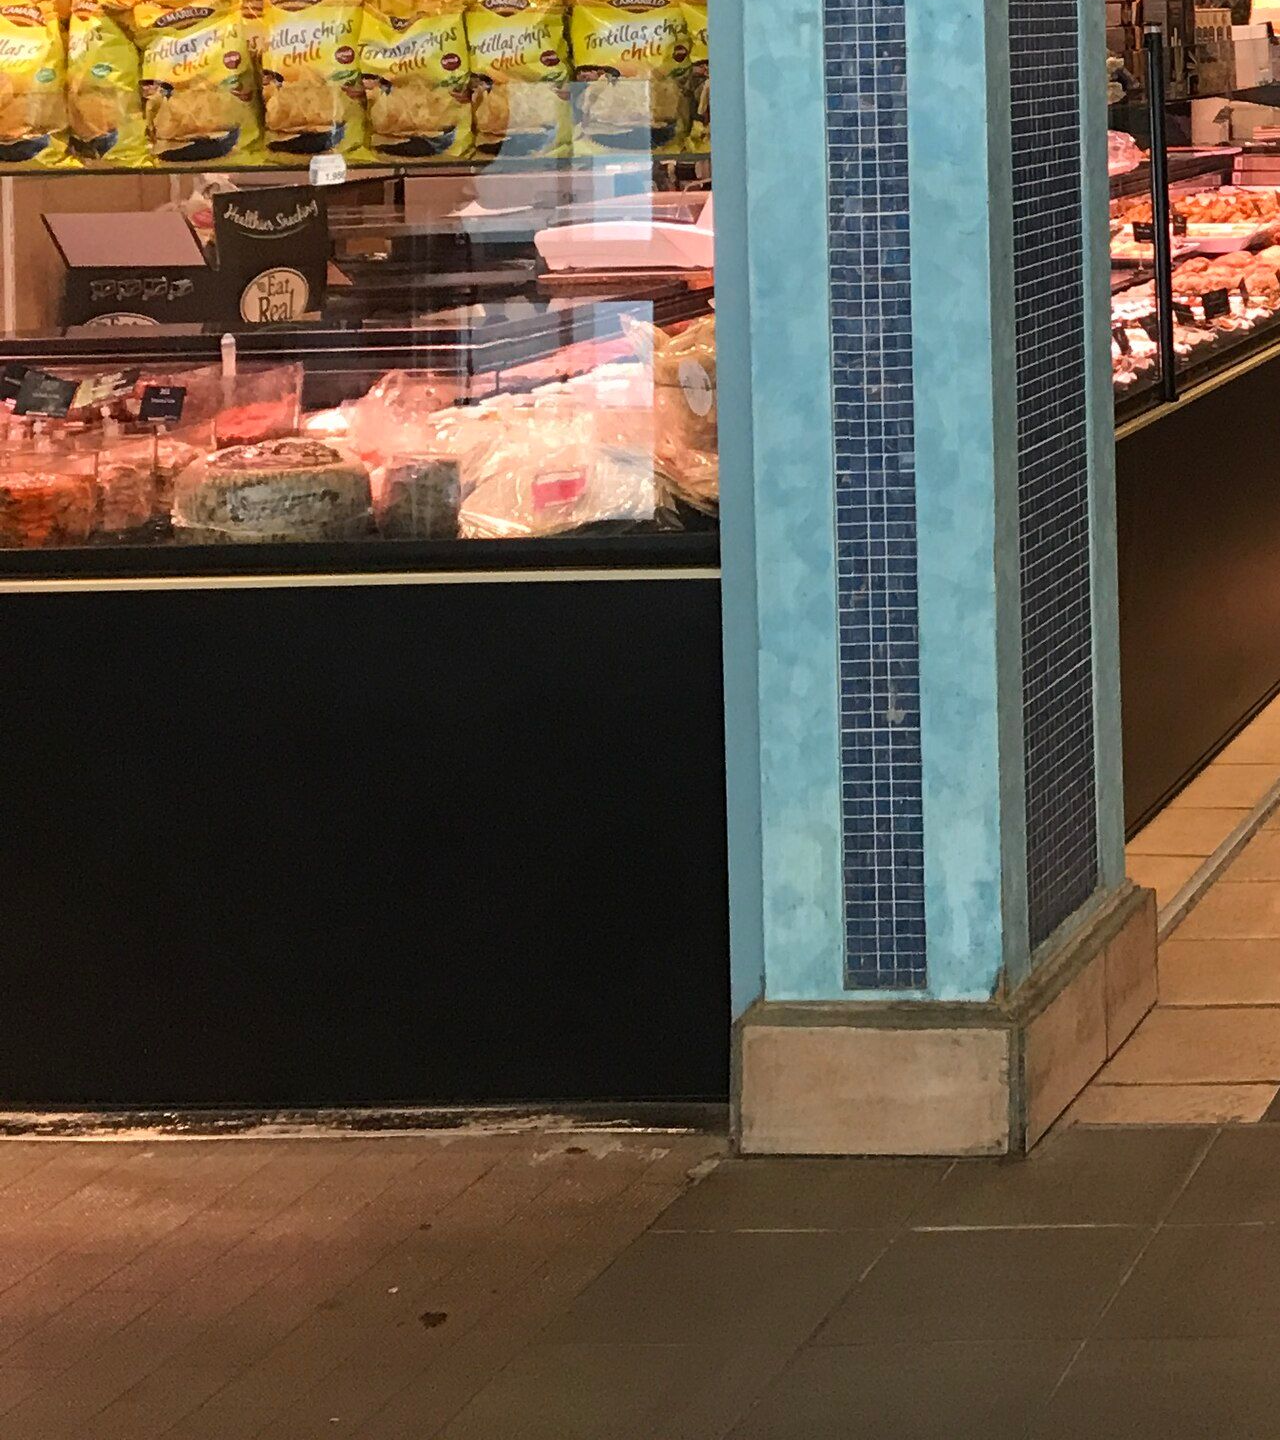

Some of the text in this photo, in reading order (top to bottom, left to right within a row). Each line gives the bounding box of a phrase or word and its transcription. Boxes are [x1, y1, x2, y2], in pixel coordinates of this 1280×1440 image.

[313, 19, 353, 44] chips
[470, 23, 552, 57] ortillas chips
[584, 23, 649, 50] Tortillas
[145, 39, 199, 64] ortillas
[283, 40, 322, 68] chili
[389, 49, 427, 74] chili
[491, 44, 527, 71] chili
[620, 38, 662, 63] chili
[267, 274, 290, 296] Eat
[258, 289, 294, 323] Real
